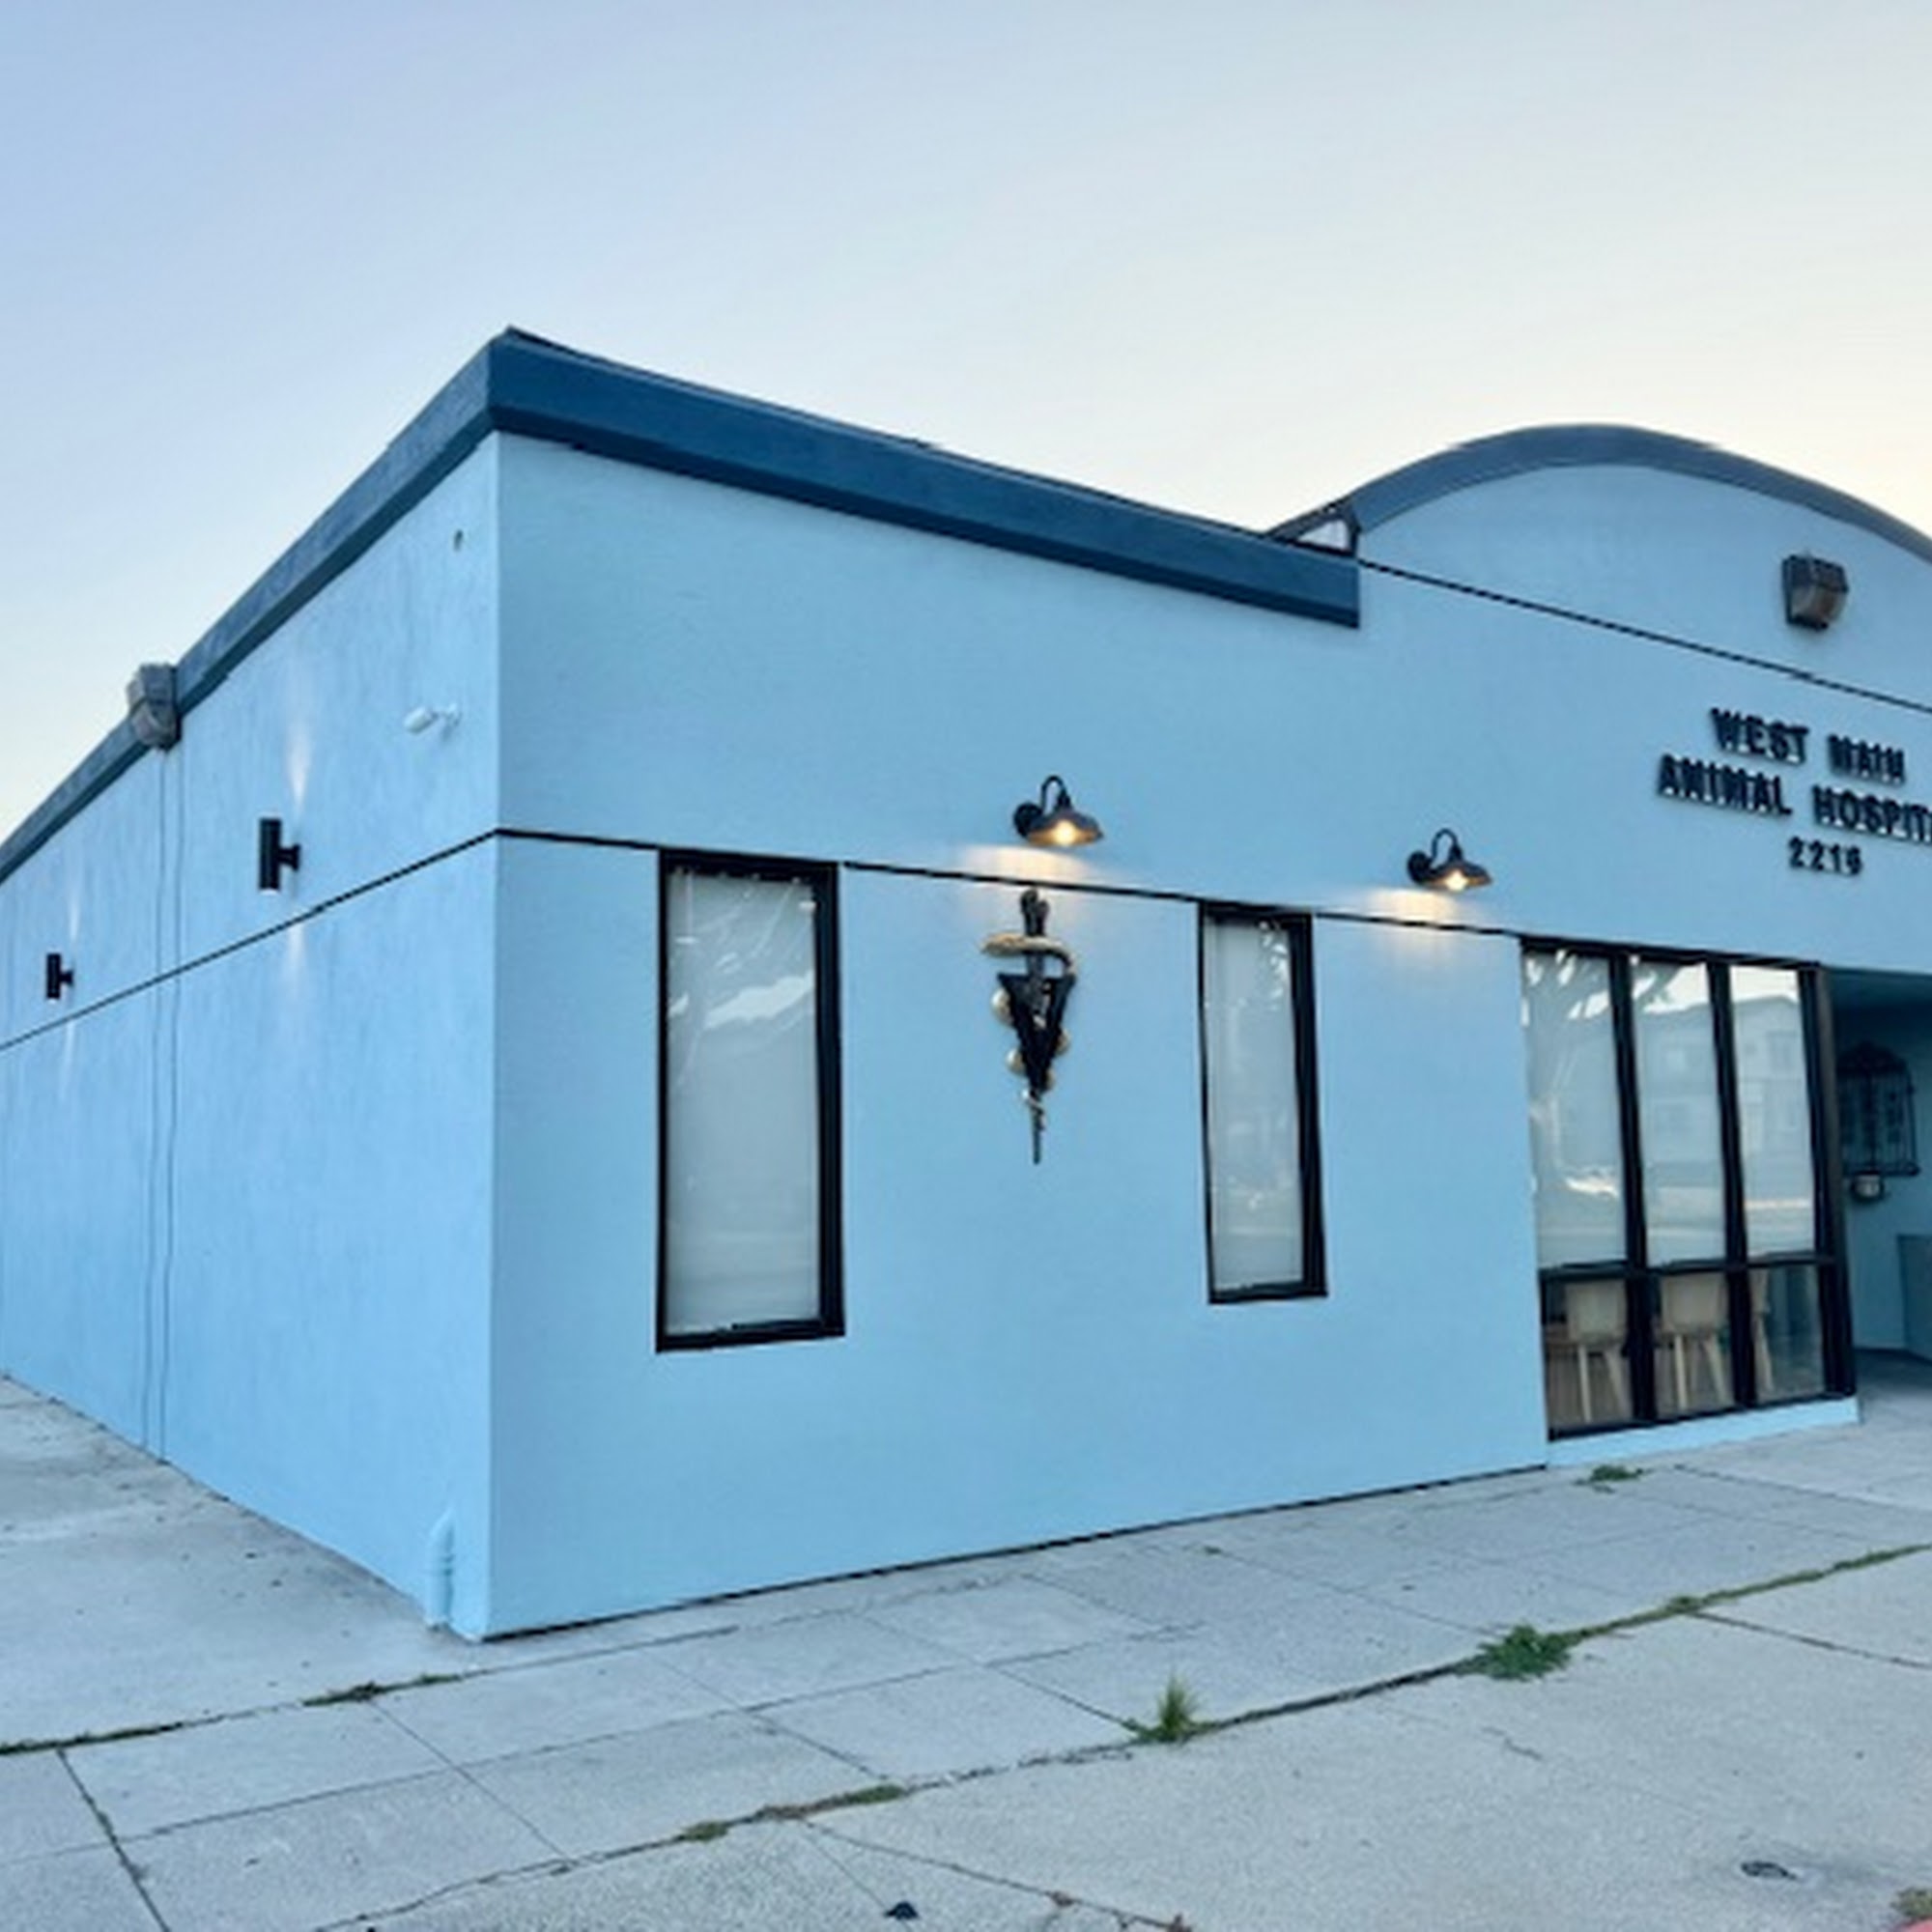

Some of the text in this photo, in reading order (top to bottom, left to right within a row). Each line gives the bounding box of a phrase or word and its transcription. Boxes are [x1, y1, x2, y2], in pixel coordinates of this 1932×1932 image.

[1709, 707, 1906, 785] WEST MAIN
[1657, 753, 1932, 844] ANIMAL HOSPIT
